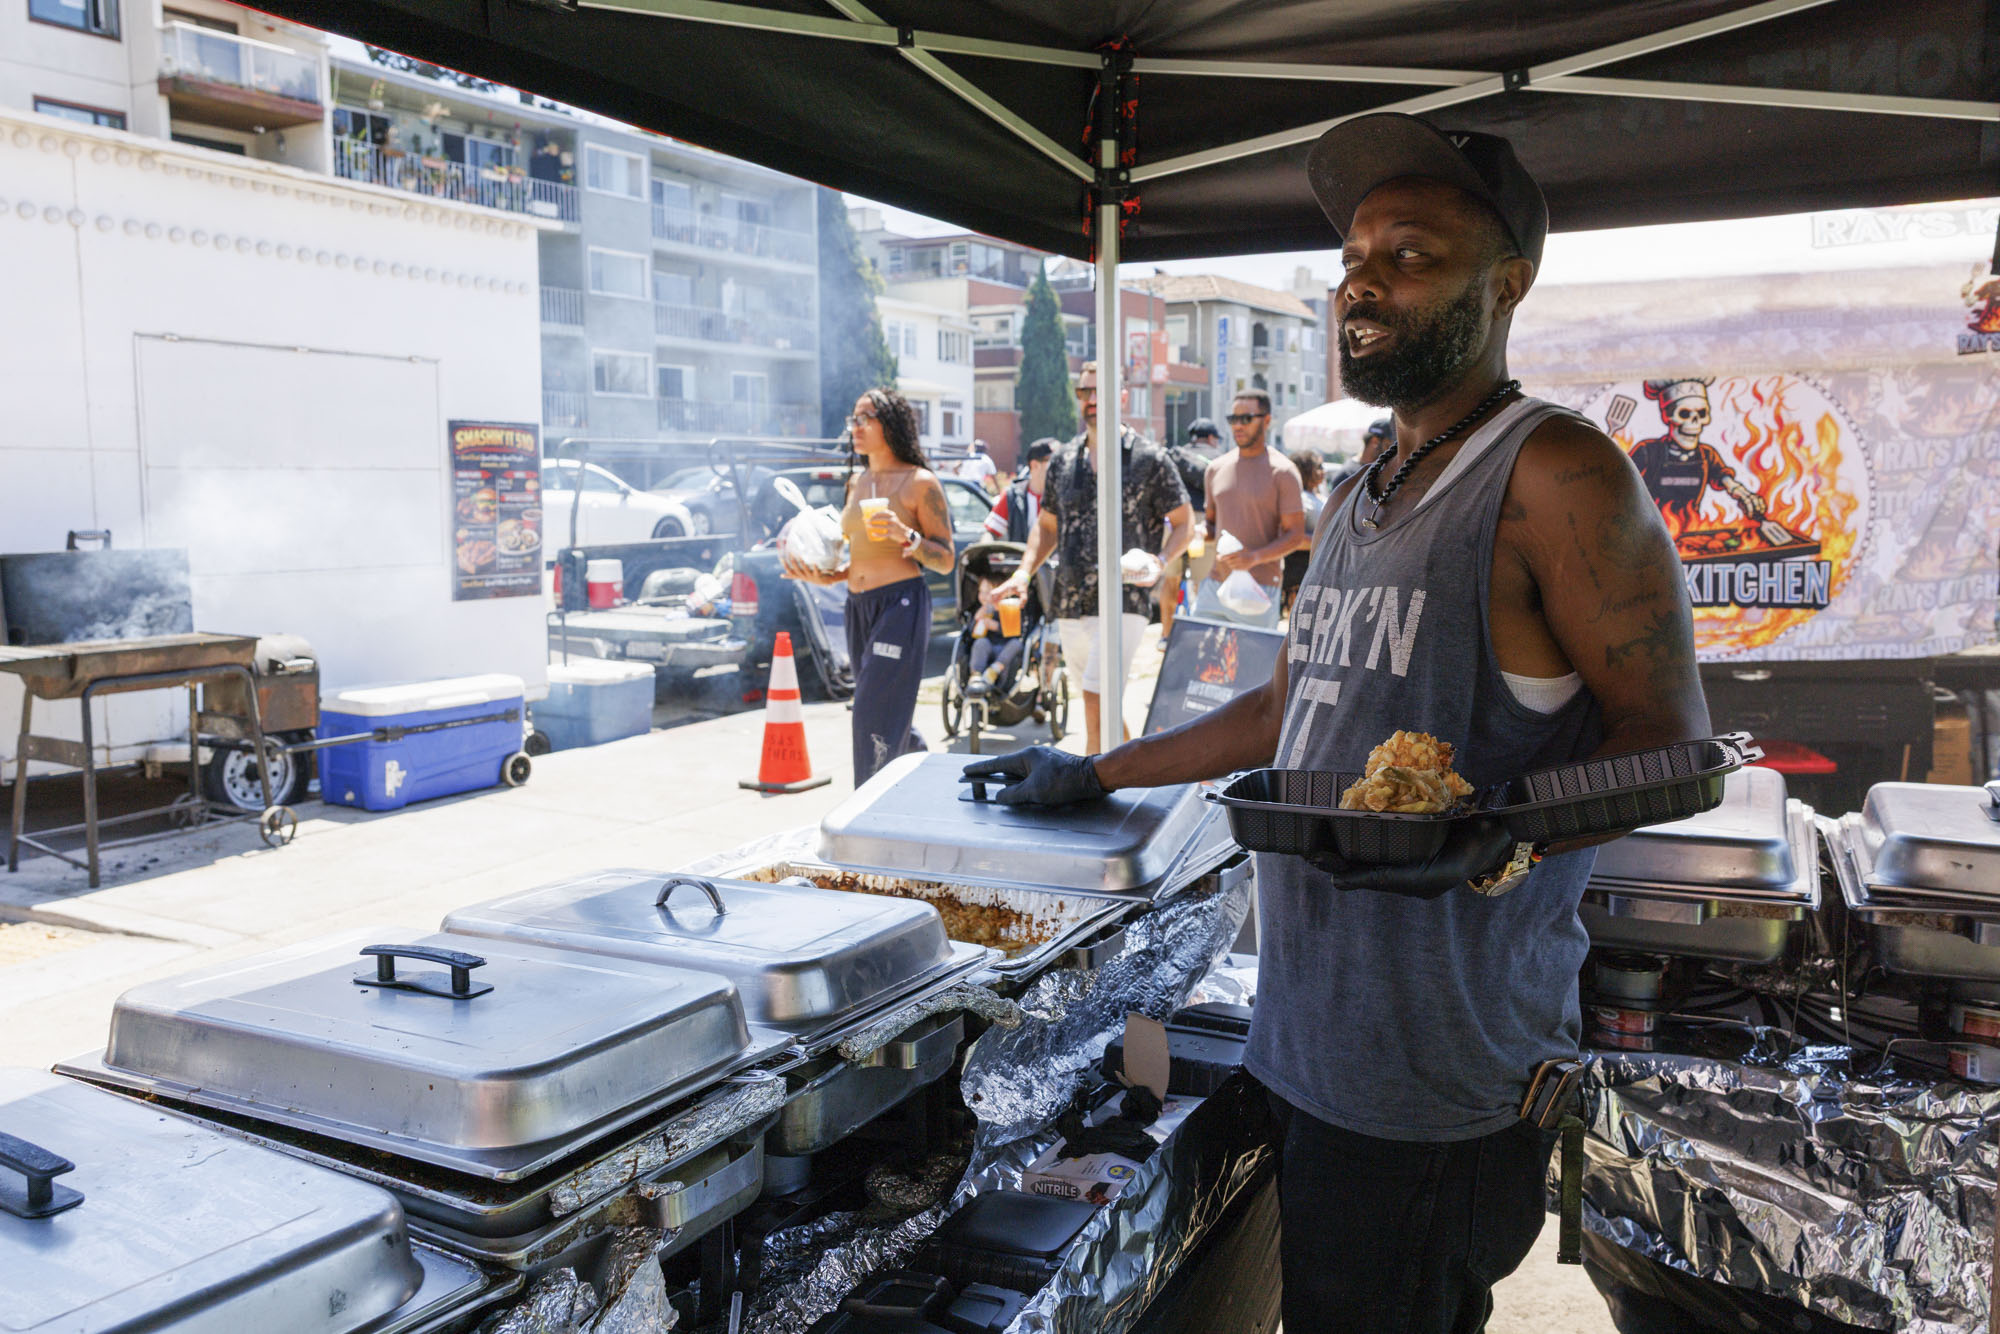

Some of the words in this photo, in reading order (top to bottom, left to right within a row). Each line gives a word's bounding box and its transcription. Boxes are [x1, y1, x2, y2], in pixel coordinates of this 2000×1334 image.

[1812, 210, 1958, 248] RAY'S
[1683, 561, 1829, 606] KITCHEN
[1034, 1182, 1078, 1198] NITRILE
